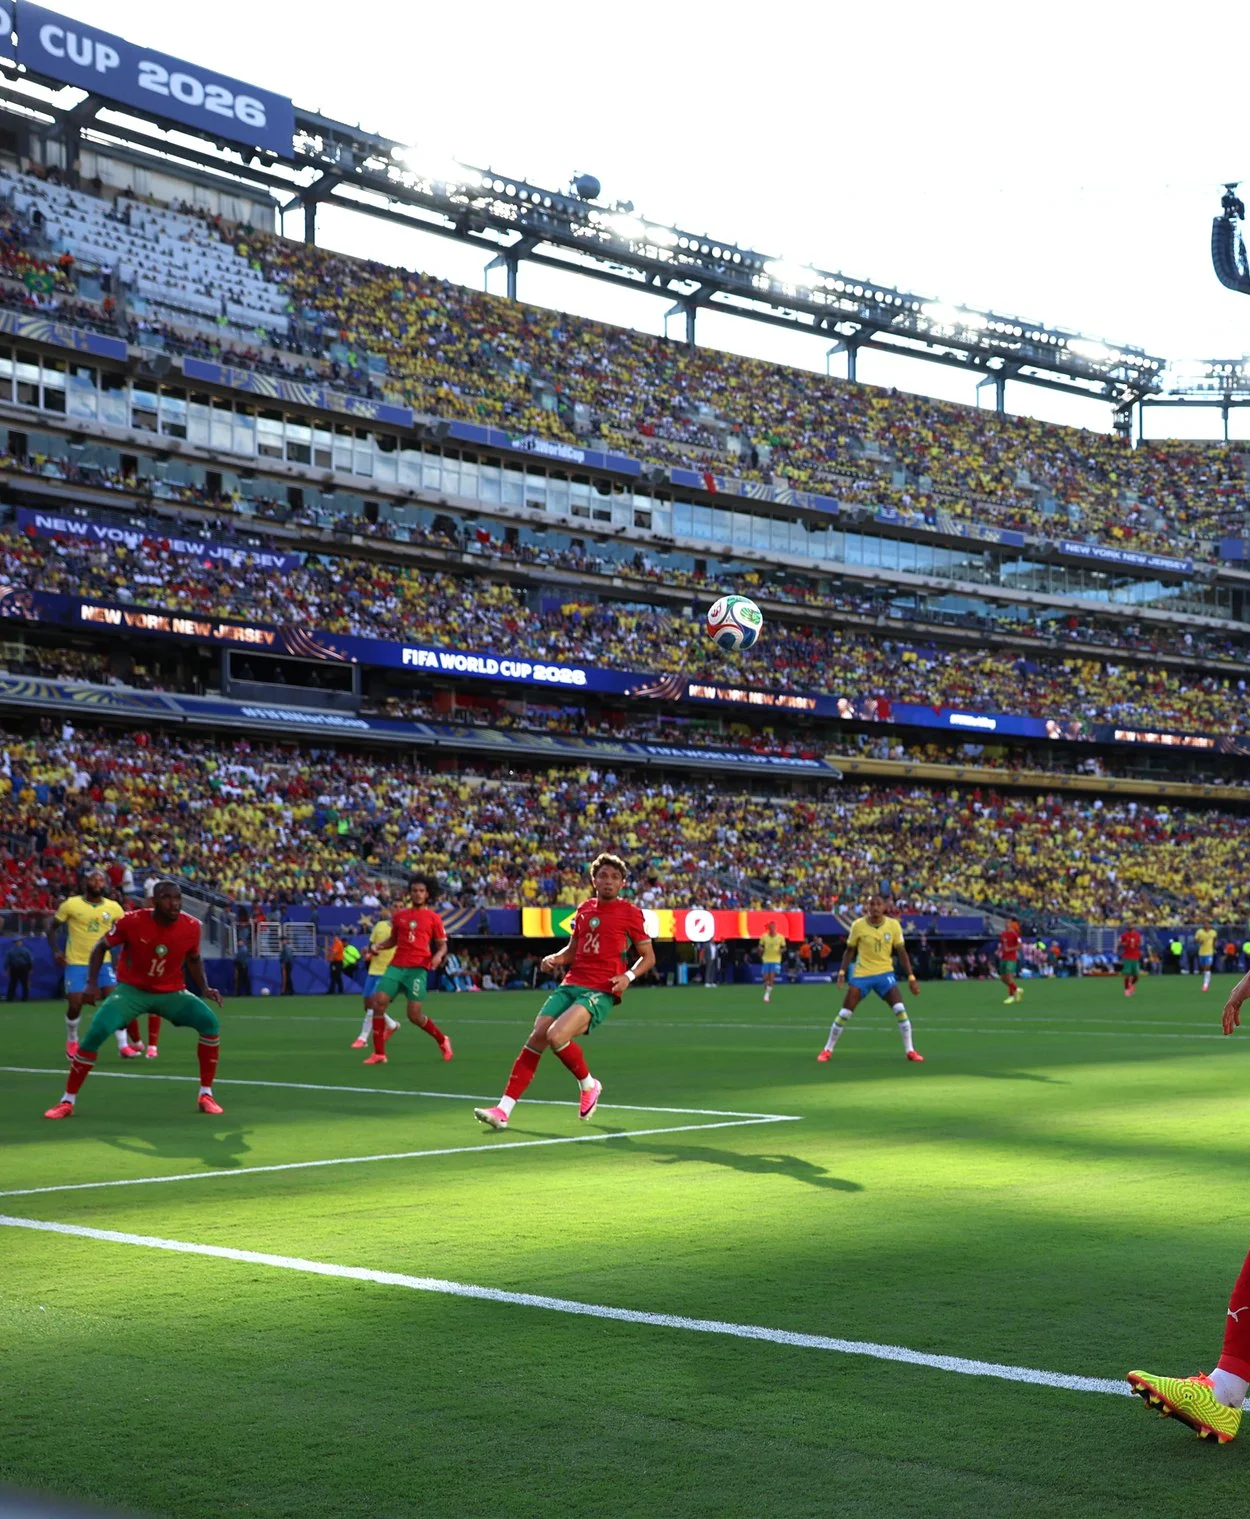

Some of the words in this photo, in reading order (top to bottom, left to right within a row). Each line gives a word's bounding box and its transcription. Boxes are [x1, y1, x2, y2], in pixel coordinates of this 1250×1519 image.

[39, 24, 120, 74] CUP
[137, 60, 268, 129] 2026
[35, 514, 88, 535] NEW
[1065, 543, 1091, 554] NEW
[1092, 547, 1121, 559] YORK
[1122, 553, 1147, 563] NEW
[1148, 558, 1188, 570] JERSEY
[81, 604, 121, 625] NEW
[124, 610, 171, 631] YORK
[172, 619, 212, 636] NEW
[213, 624, 276, 645] JERSEY
[402, 648, 439, 667] FIFA
[439, 653, 499, 674] WORLD
[500, 661, 532, 678] CUP
[532, 665, 587, 685] 2026
[685, 909, 715, 943] 0
[583, 933, 600, 954] 24
[148, 959, 167, 977] 14
